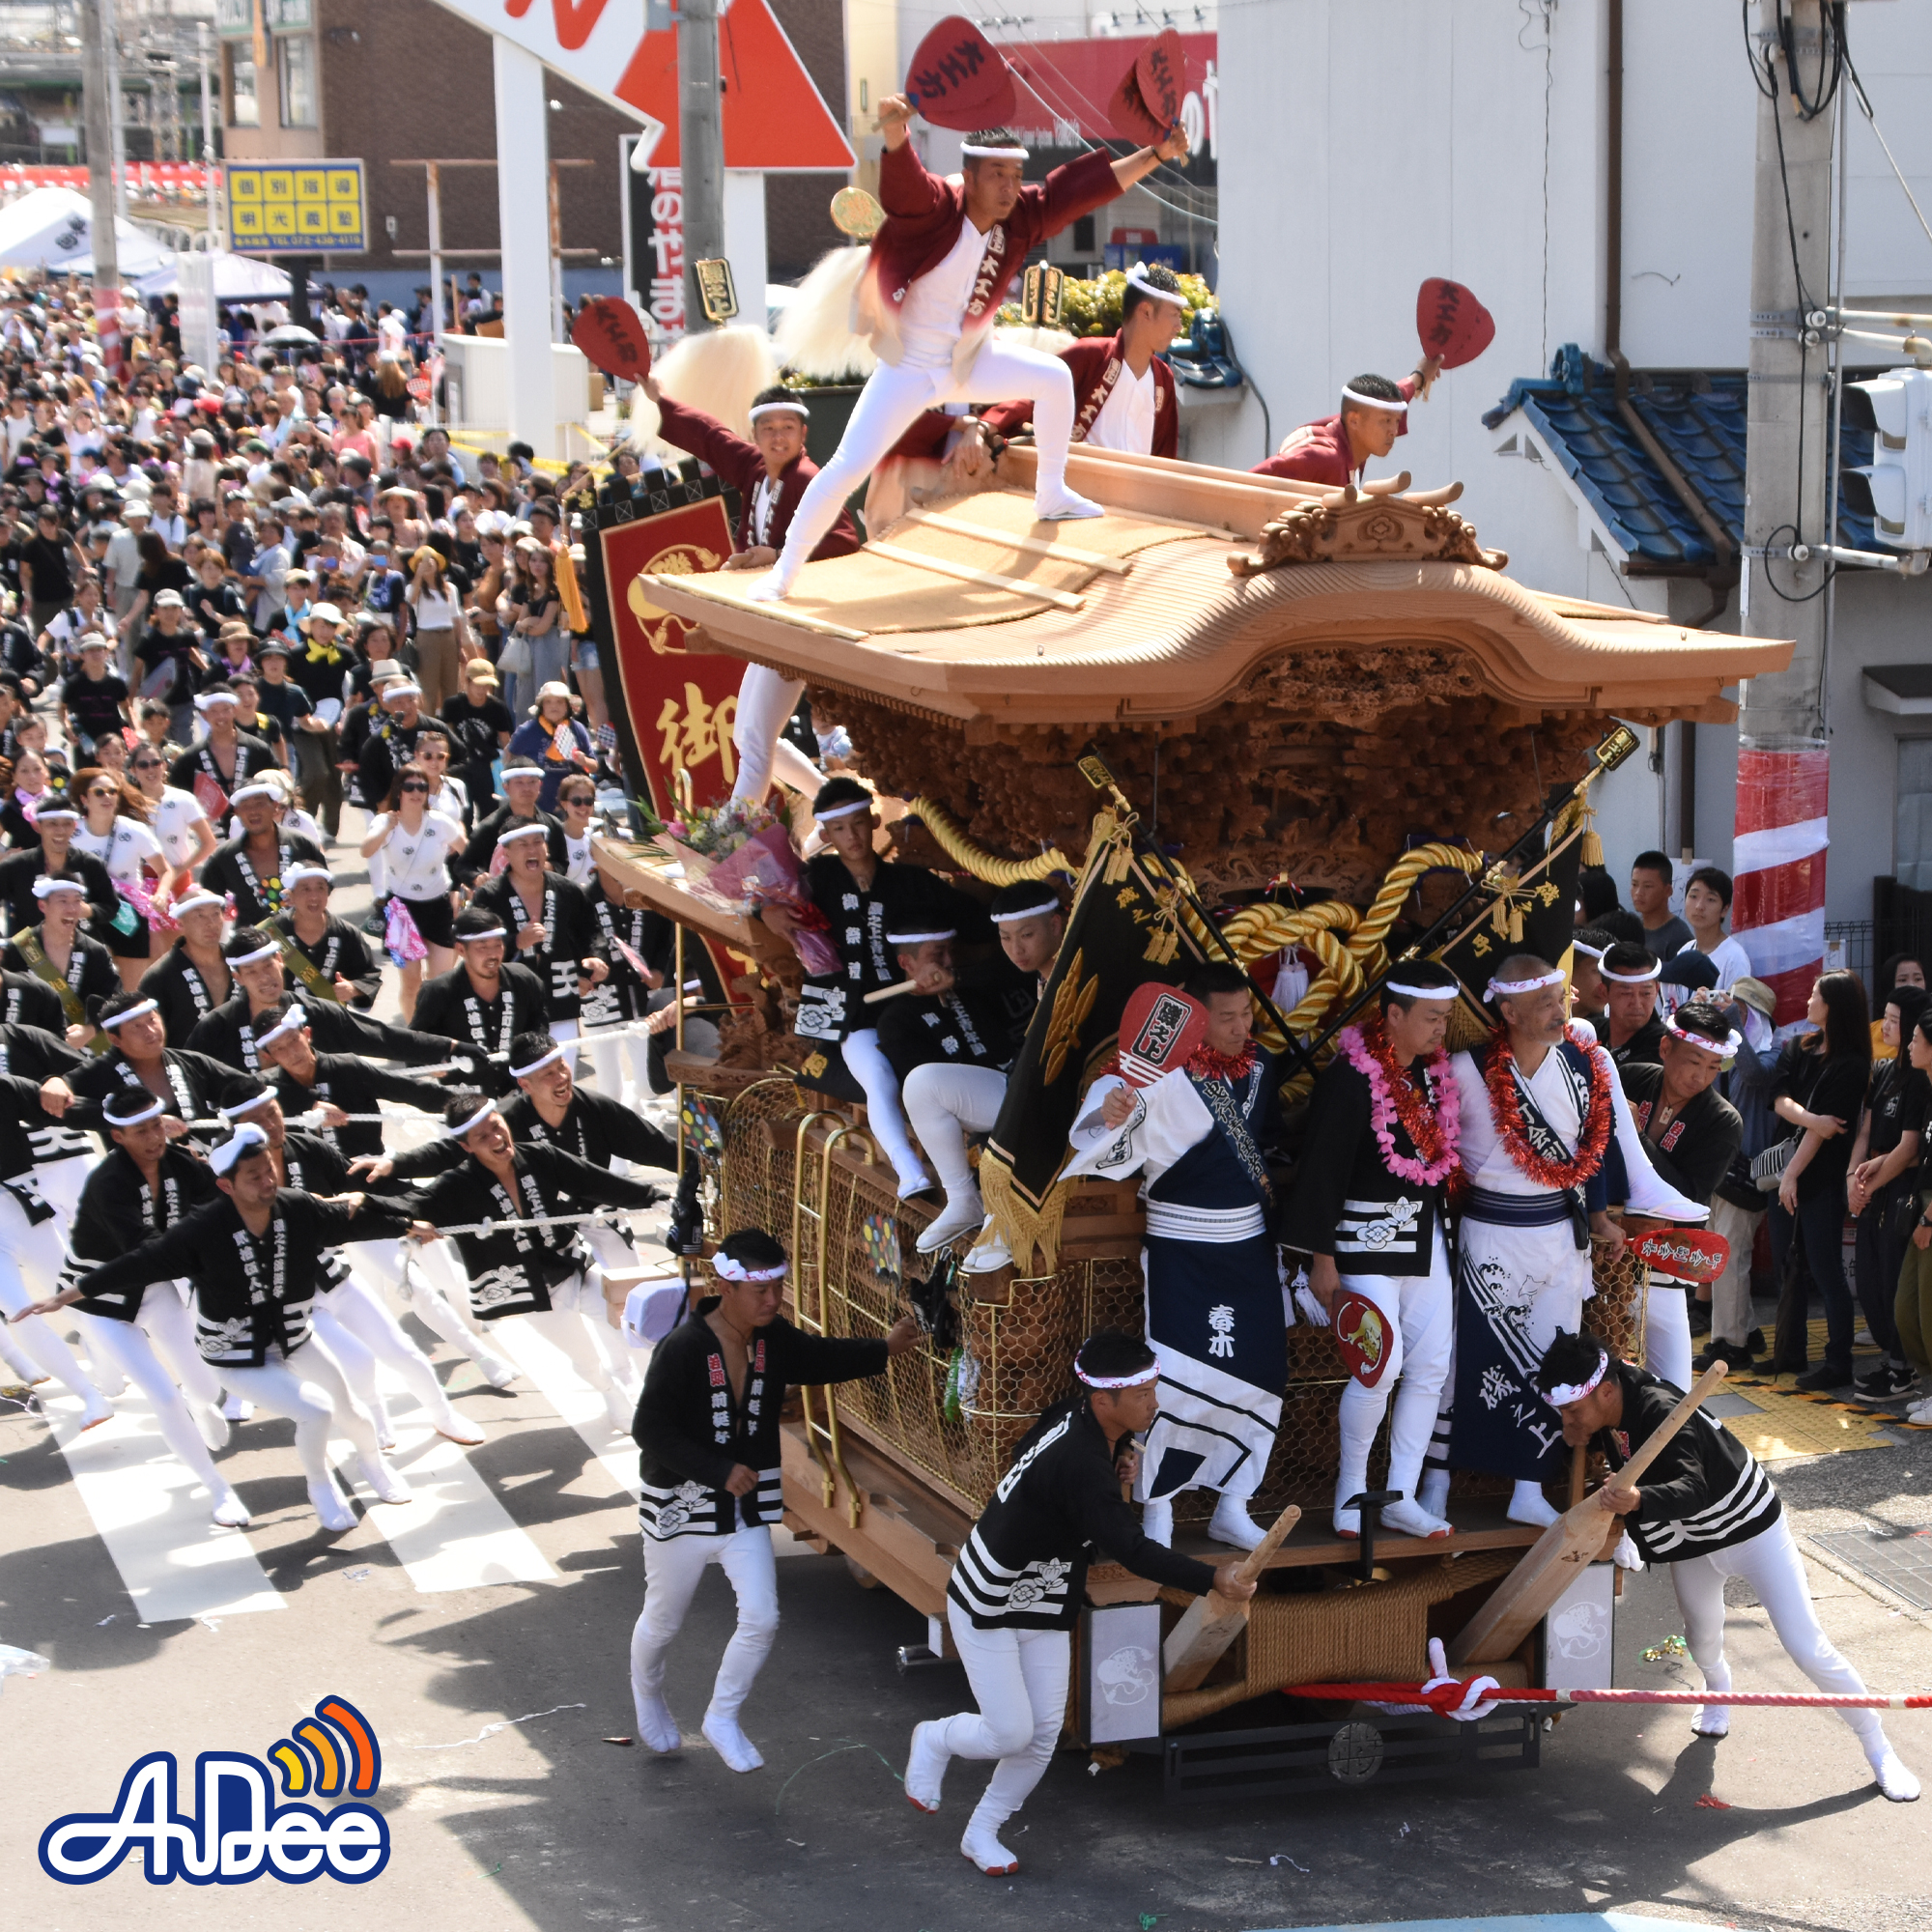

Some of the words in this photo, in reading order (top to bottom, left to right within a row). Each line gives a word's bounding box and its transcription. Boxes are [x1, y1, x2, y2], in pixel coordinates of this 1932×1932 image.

[1149, 1000, 1184, 1064] 磯之上
[1208, 1303, 1236, 1358] 春木
[1479, 1364, 1562, 1461] 磯之上
